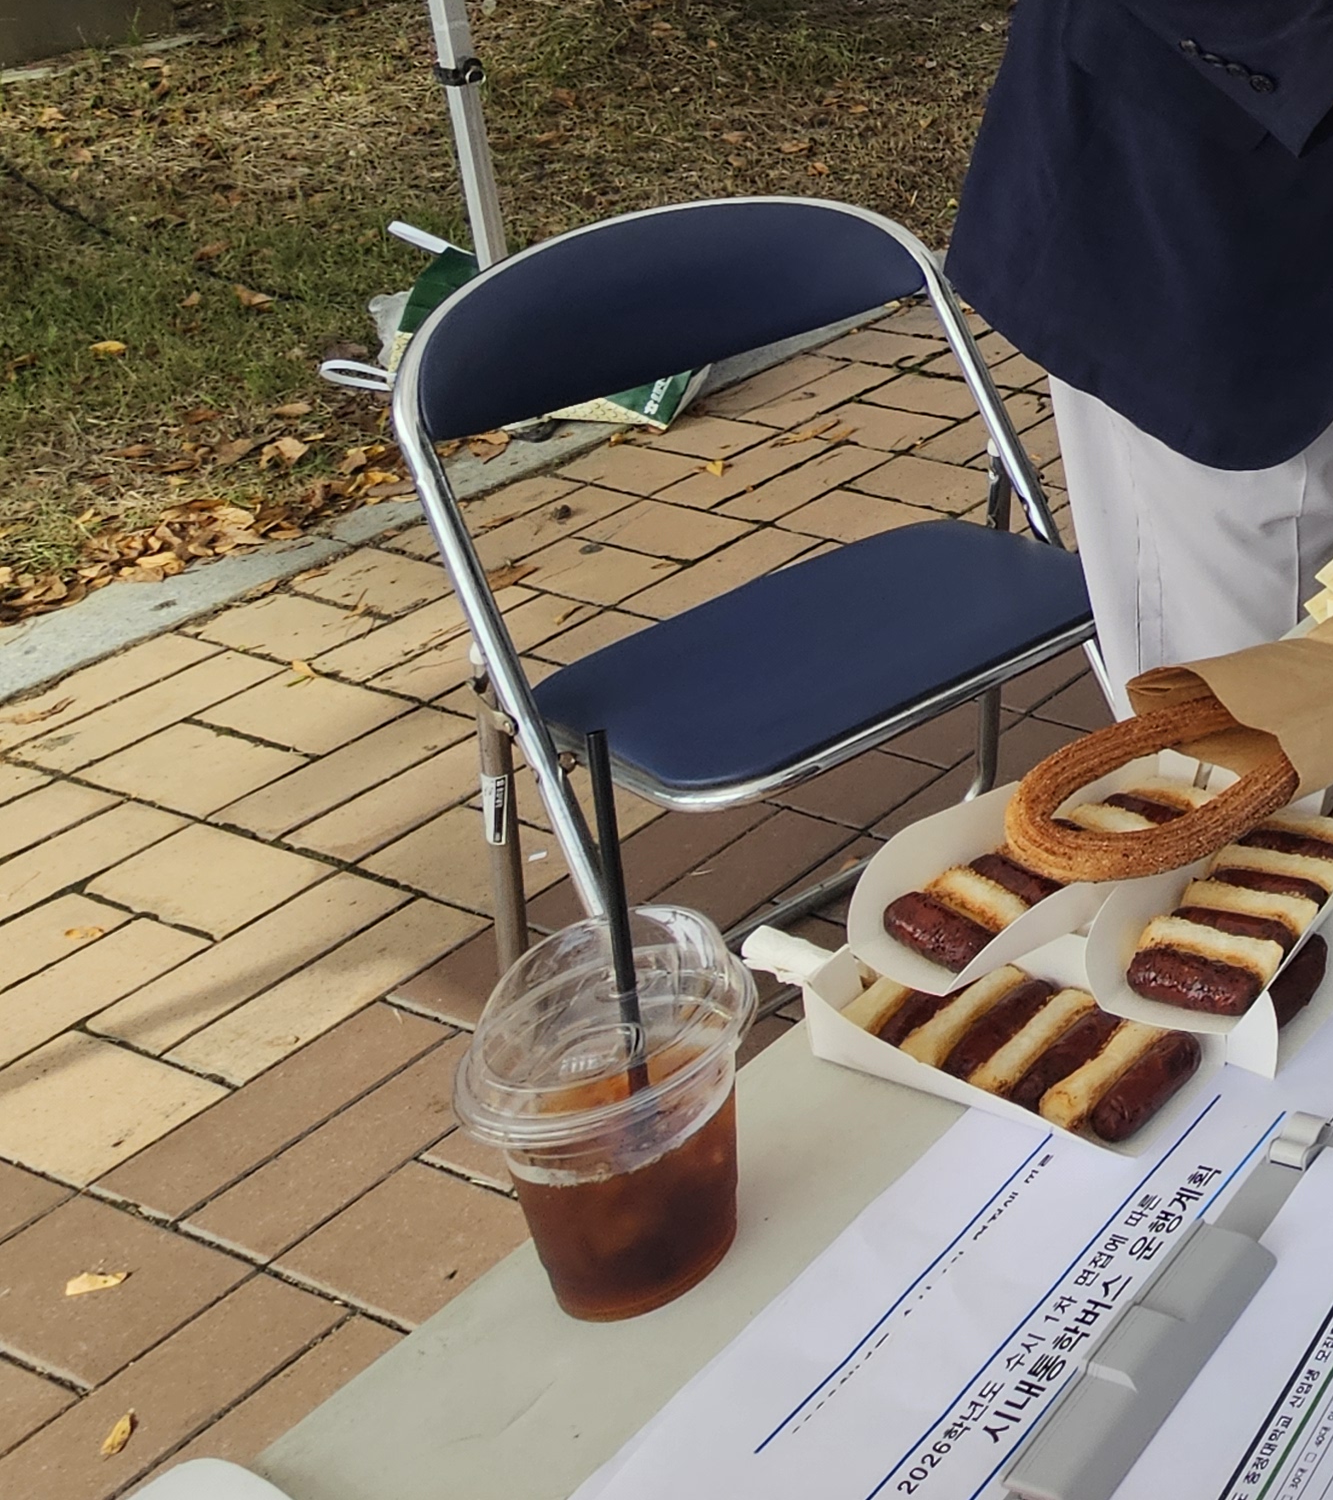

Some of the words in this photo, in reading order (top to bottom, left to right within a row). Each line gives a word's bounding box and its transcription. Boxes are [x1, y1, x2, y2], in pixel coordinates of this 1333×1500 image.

[897, 1380, 1005, 1495] 2026학년도
[1005, 1332, 1046, 1372] 수시
[1044, 1294, 1078, 1325] 1차
[1073, 1232, 1127, 1288] 면접에
[1124, 1193, 1163, 1229] 따른
[982, 1274, 1134, 1445] 시내통학버스
[1129, 1164, 1222, 1262] 운행계획
